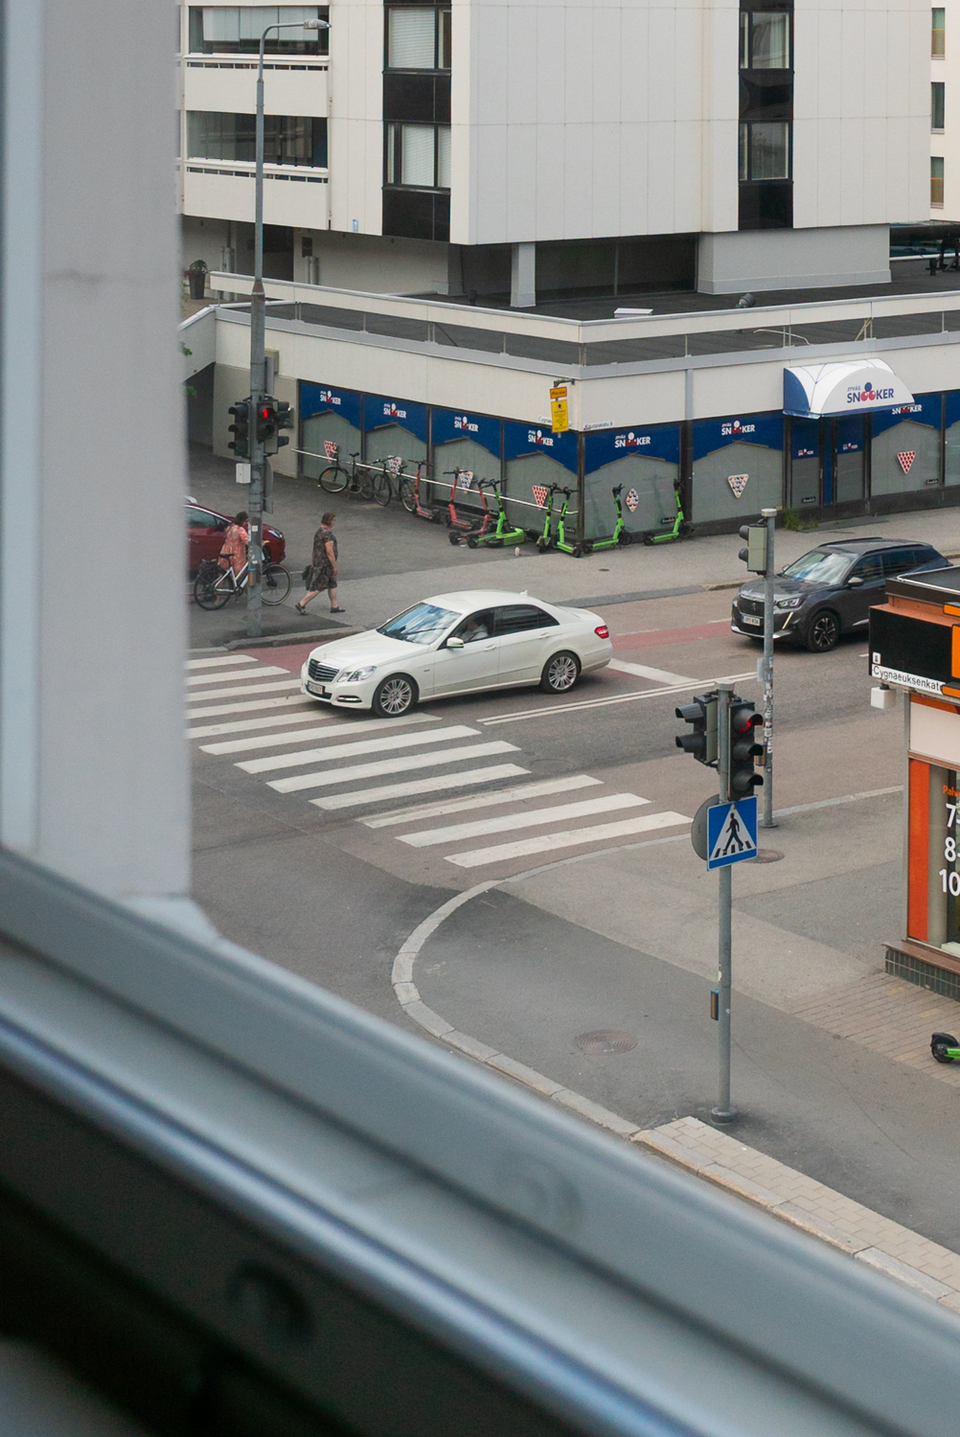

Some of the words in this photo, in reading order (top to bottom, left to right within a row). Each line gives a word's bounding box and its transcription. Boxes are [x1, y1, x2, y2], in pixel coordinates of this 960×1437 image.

[847, 388, 894, 403] SNOOKER
[892, 404, 922, 415] SNOOKER
[721, 424, 755, 436] SNOOKER
[614, 436, 651, 448] SNOOKER
[873, 665, 942, 691] Cygnaeuksenkat
